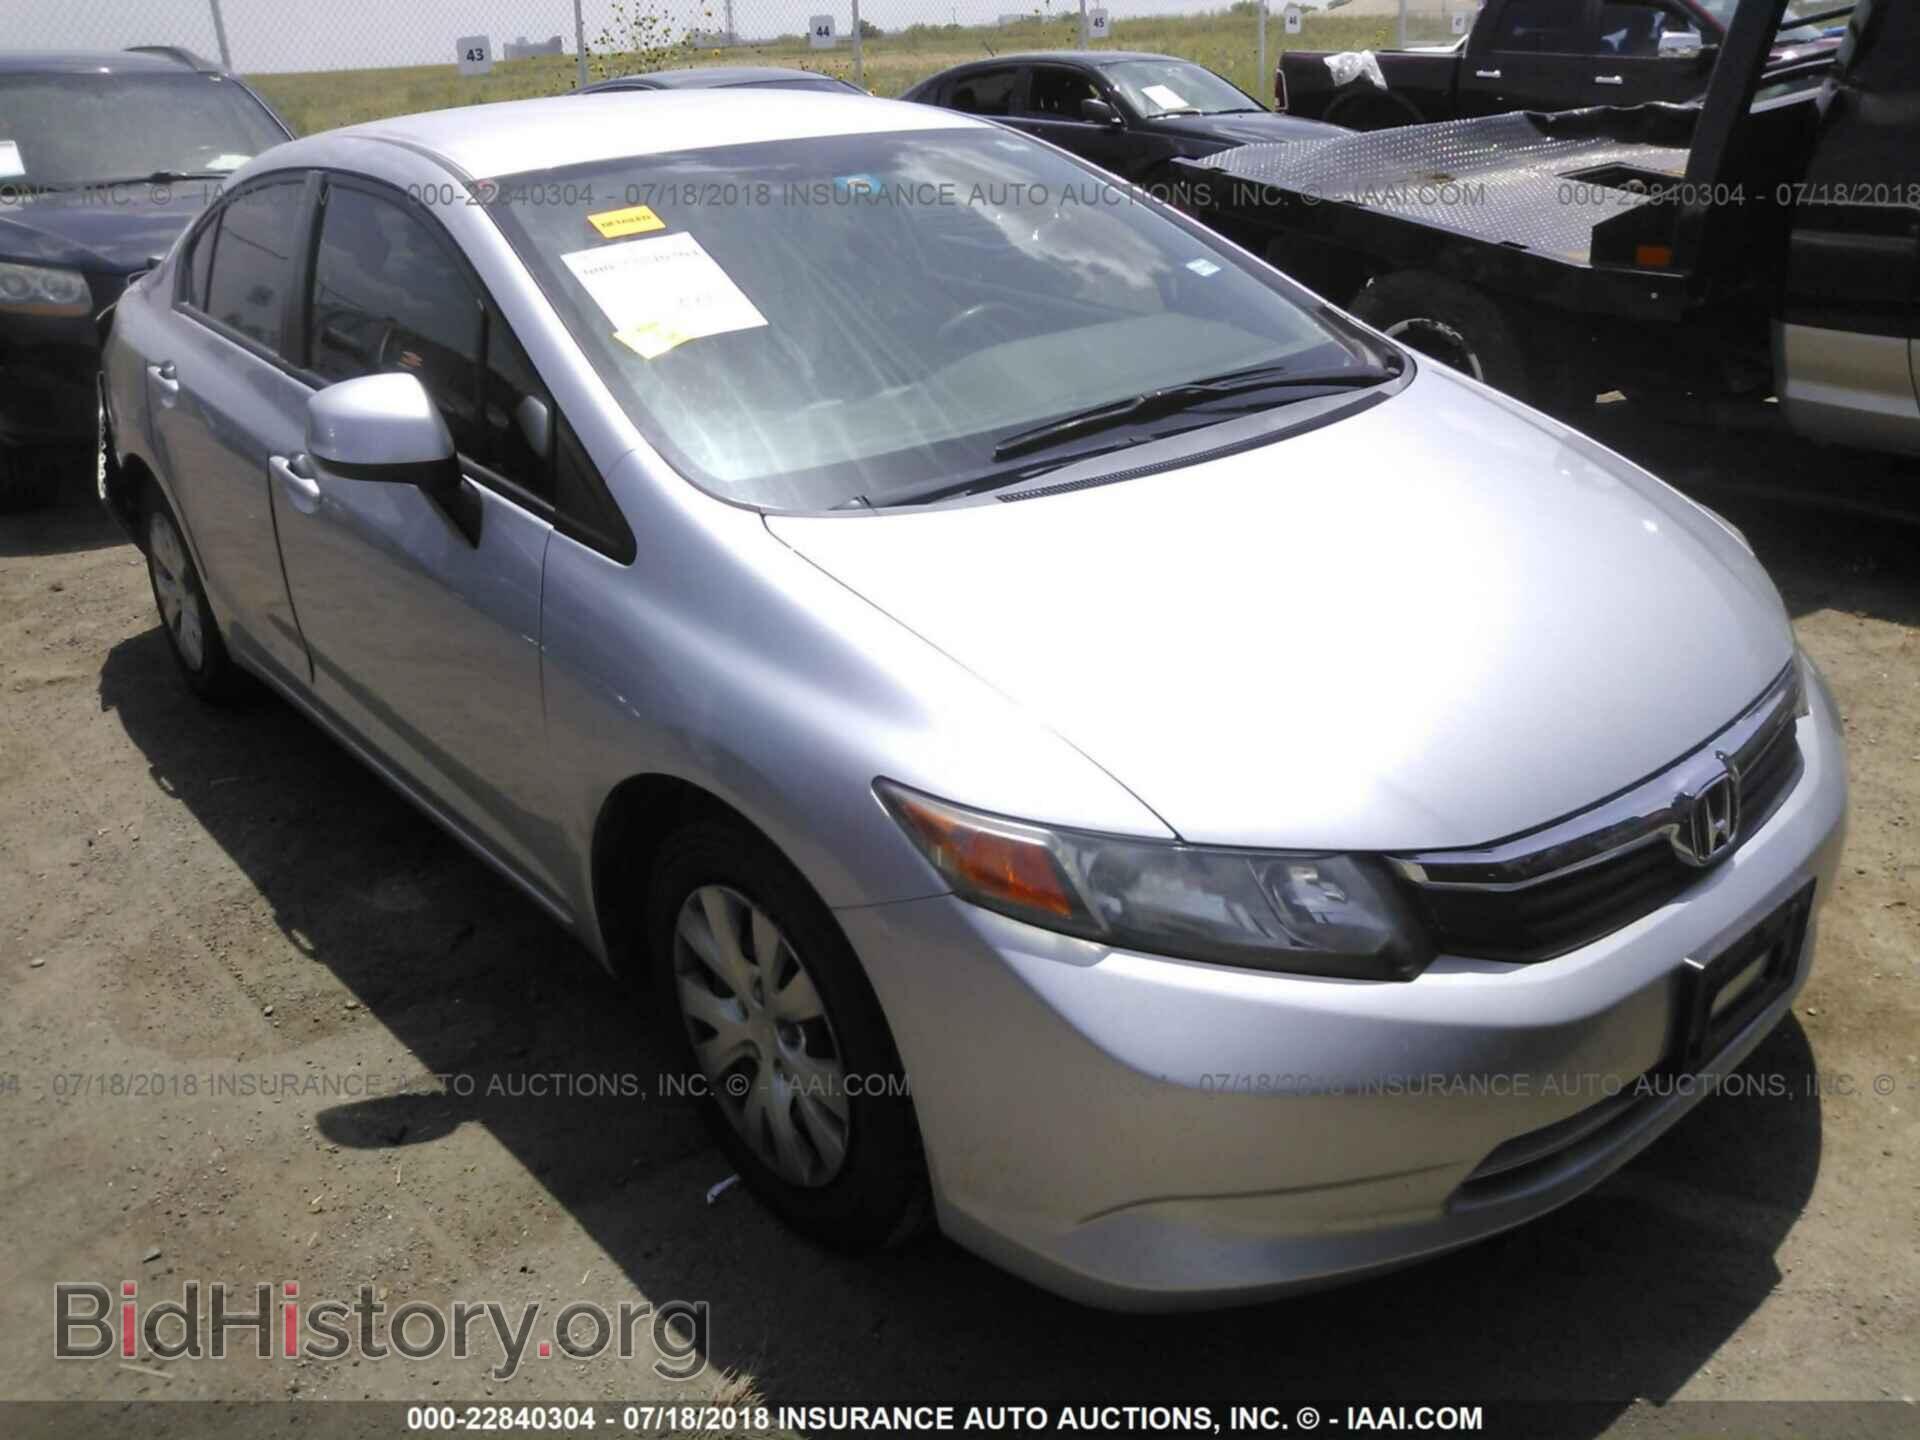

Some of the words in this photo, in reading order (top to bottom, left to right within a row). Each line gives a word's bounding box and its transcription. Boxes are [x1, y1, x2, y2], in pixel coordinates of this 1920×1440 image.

[1093, 16, 1105, 28] 45
[816, 25, 830, 36] 44
[466, 47, 484, 61] 43
